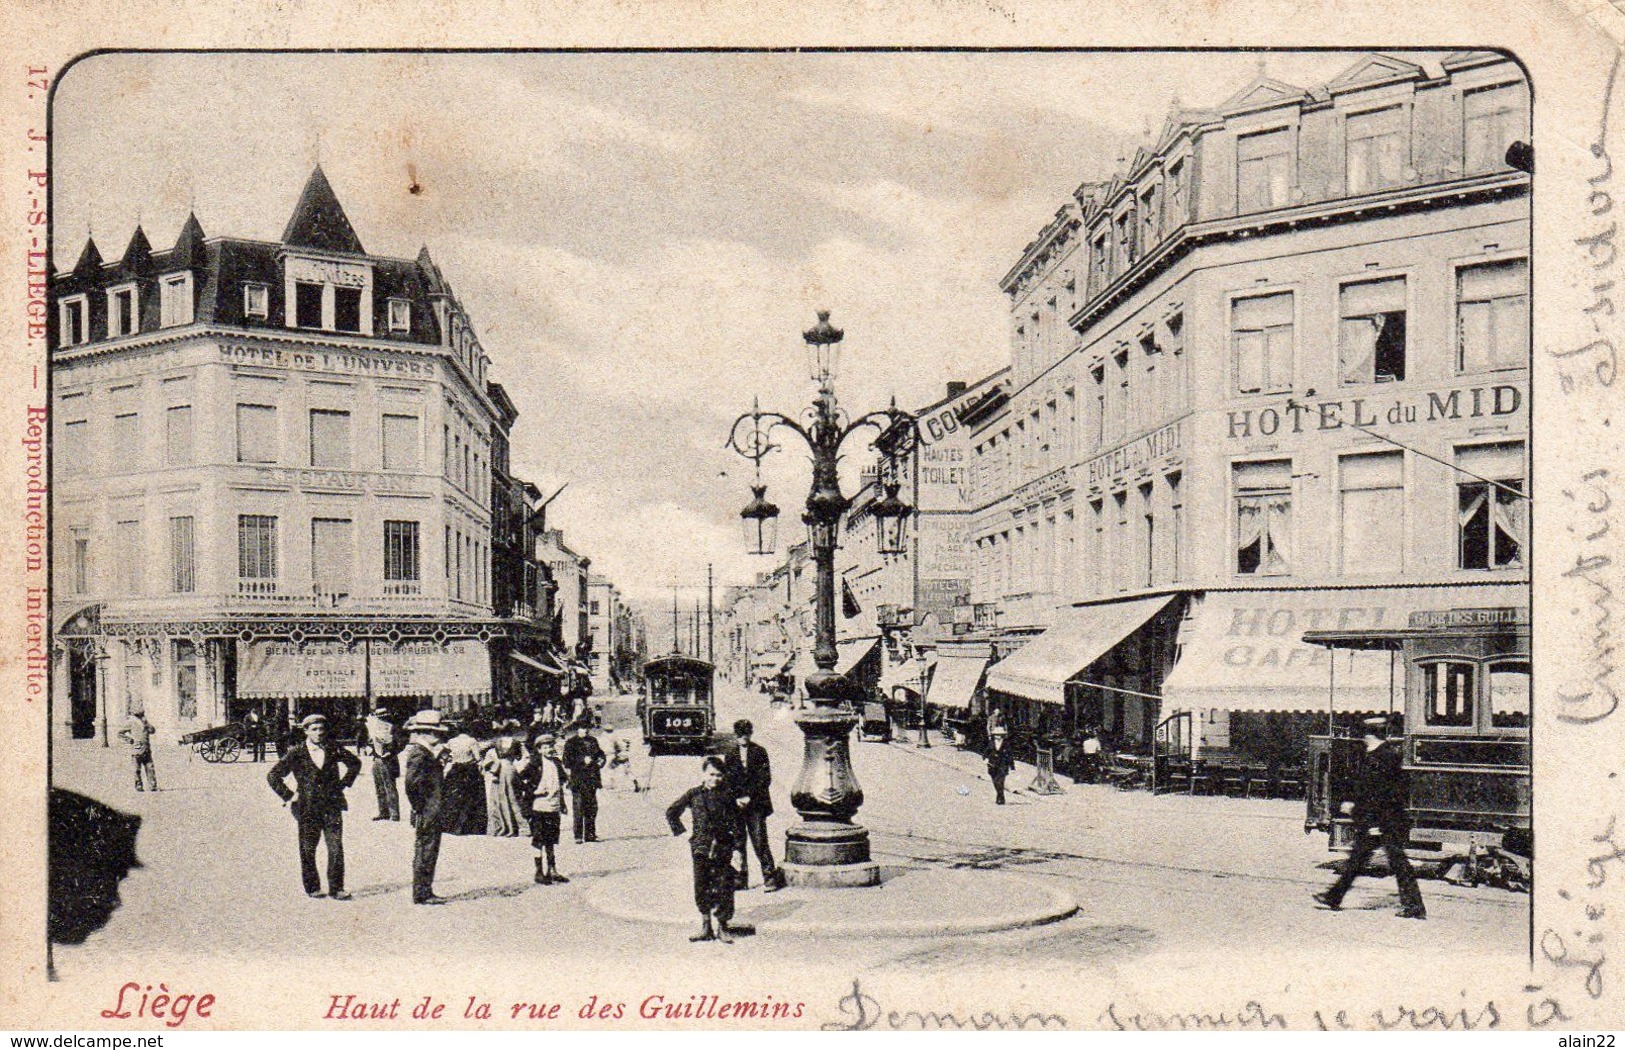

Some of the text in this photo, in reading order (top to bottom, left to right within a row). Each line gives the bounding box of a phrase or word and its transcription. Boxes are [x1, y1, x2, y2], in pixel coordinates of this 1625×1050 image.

[217, 343, 289, 367] HOTEL
[293, 353, 315, 370] DE
[1226, 385, 1523, 438] HOTEL du MID
[1088, 449, 1131, 484] HOTEL
[1146, 423, 1182, 462] MIDI
[1225, 607, 1388, 637] HOTEL
